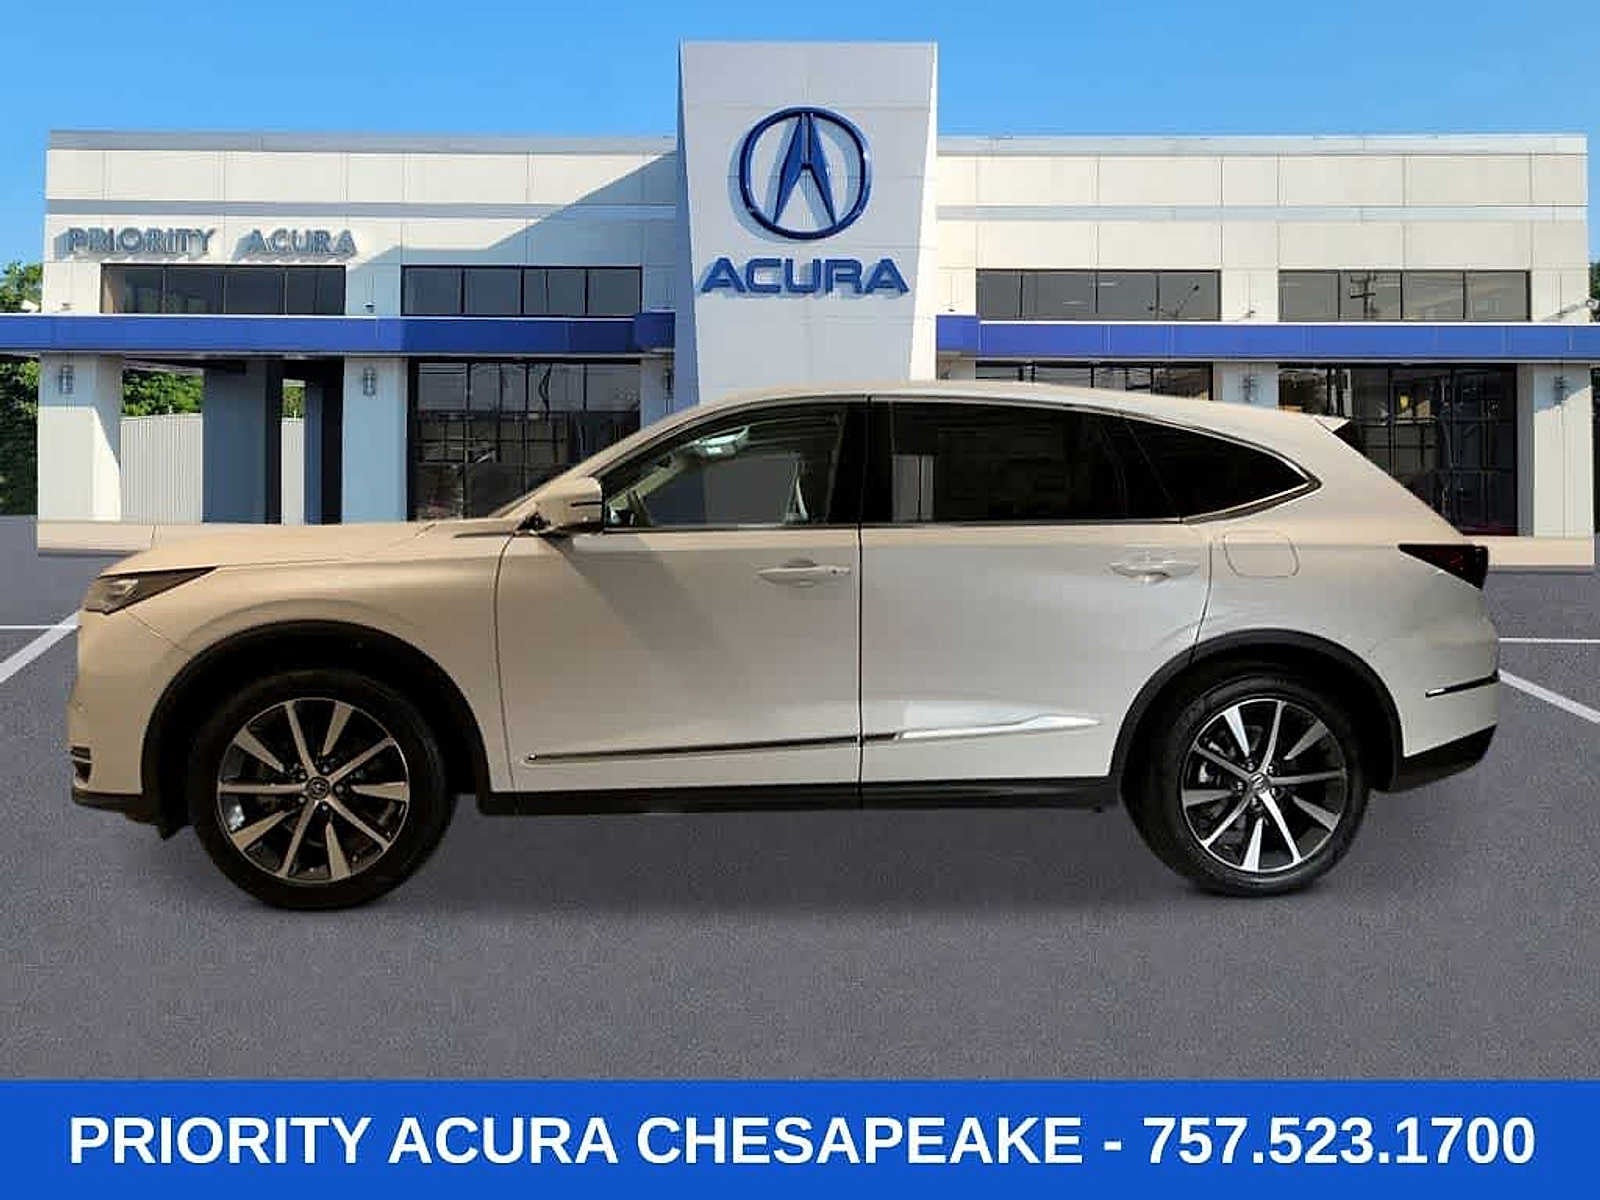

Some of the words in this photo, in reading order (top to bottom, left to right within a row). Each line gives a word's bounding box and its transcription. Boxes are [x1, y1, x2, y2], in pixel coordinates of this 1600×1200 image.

[67, 227, 215, 254] PRIORITY
[246, 229, 357, 256] ACURA
[700, 257, 909, 294] ACURA
